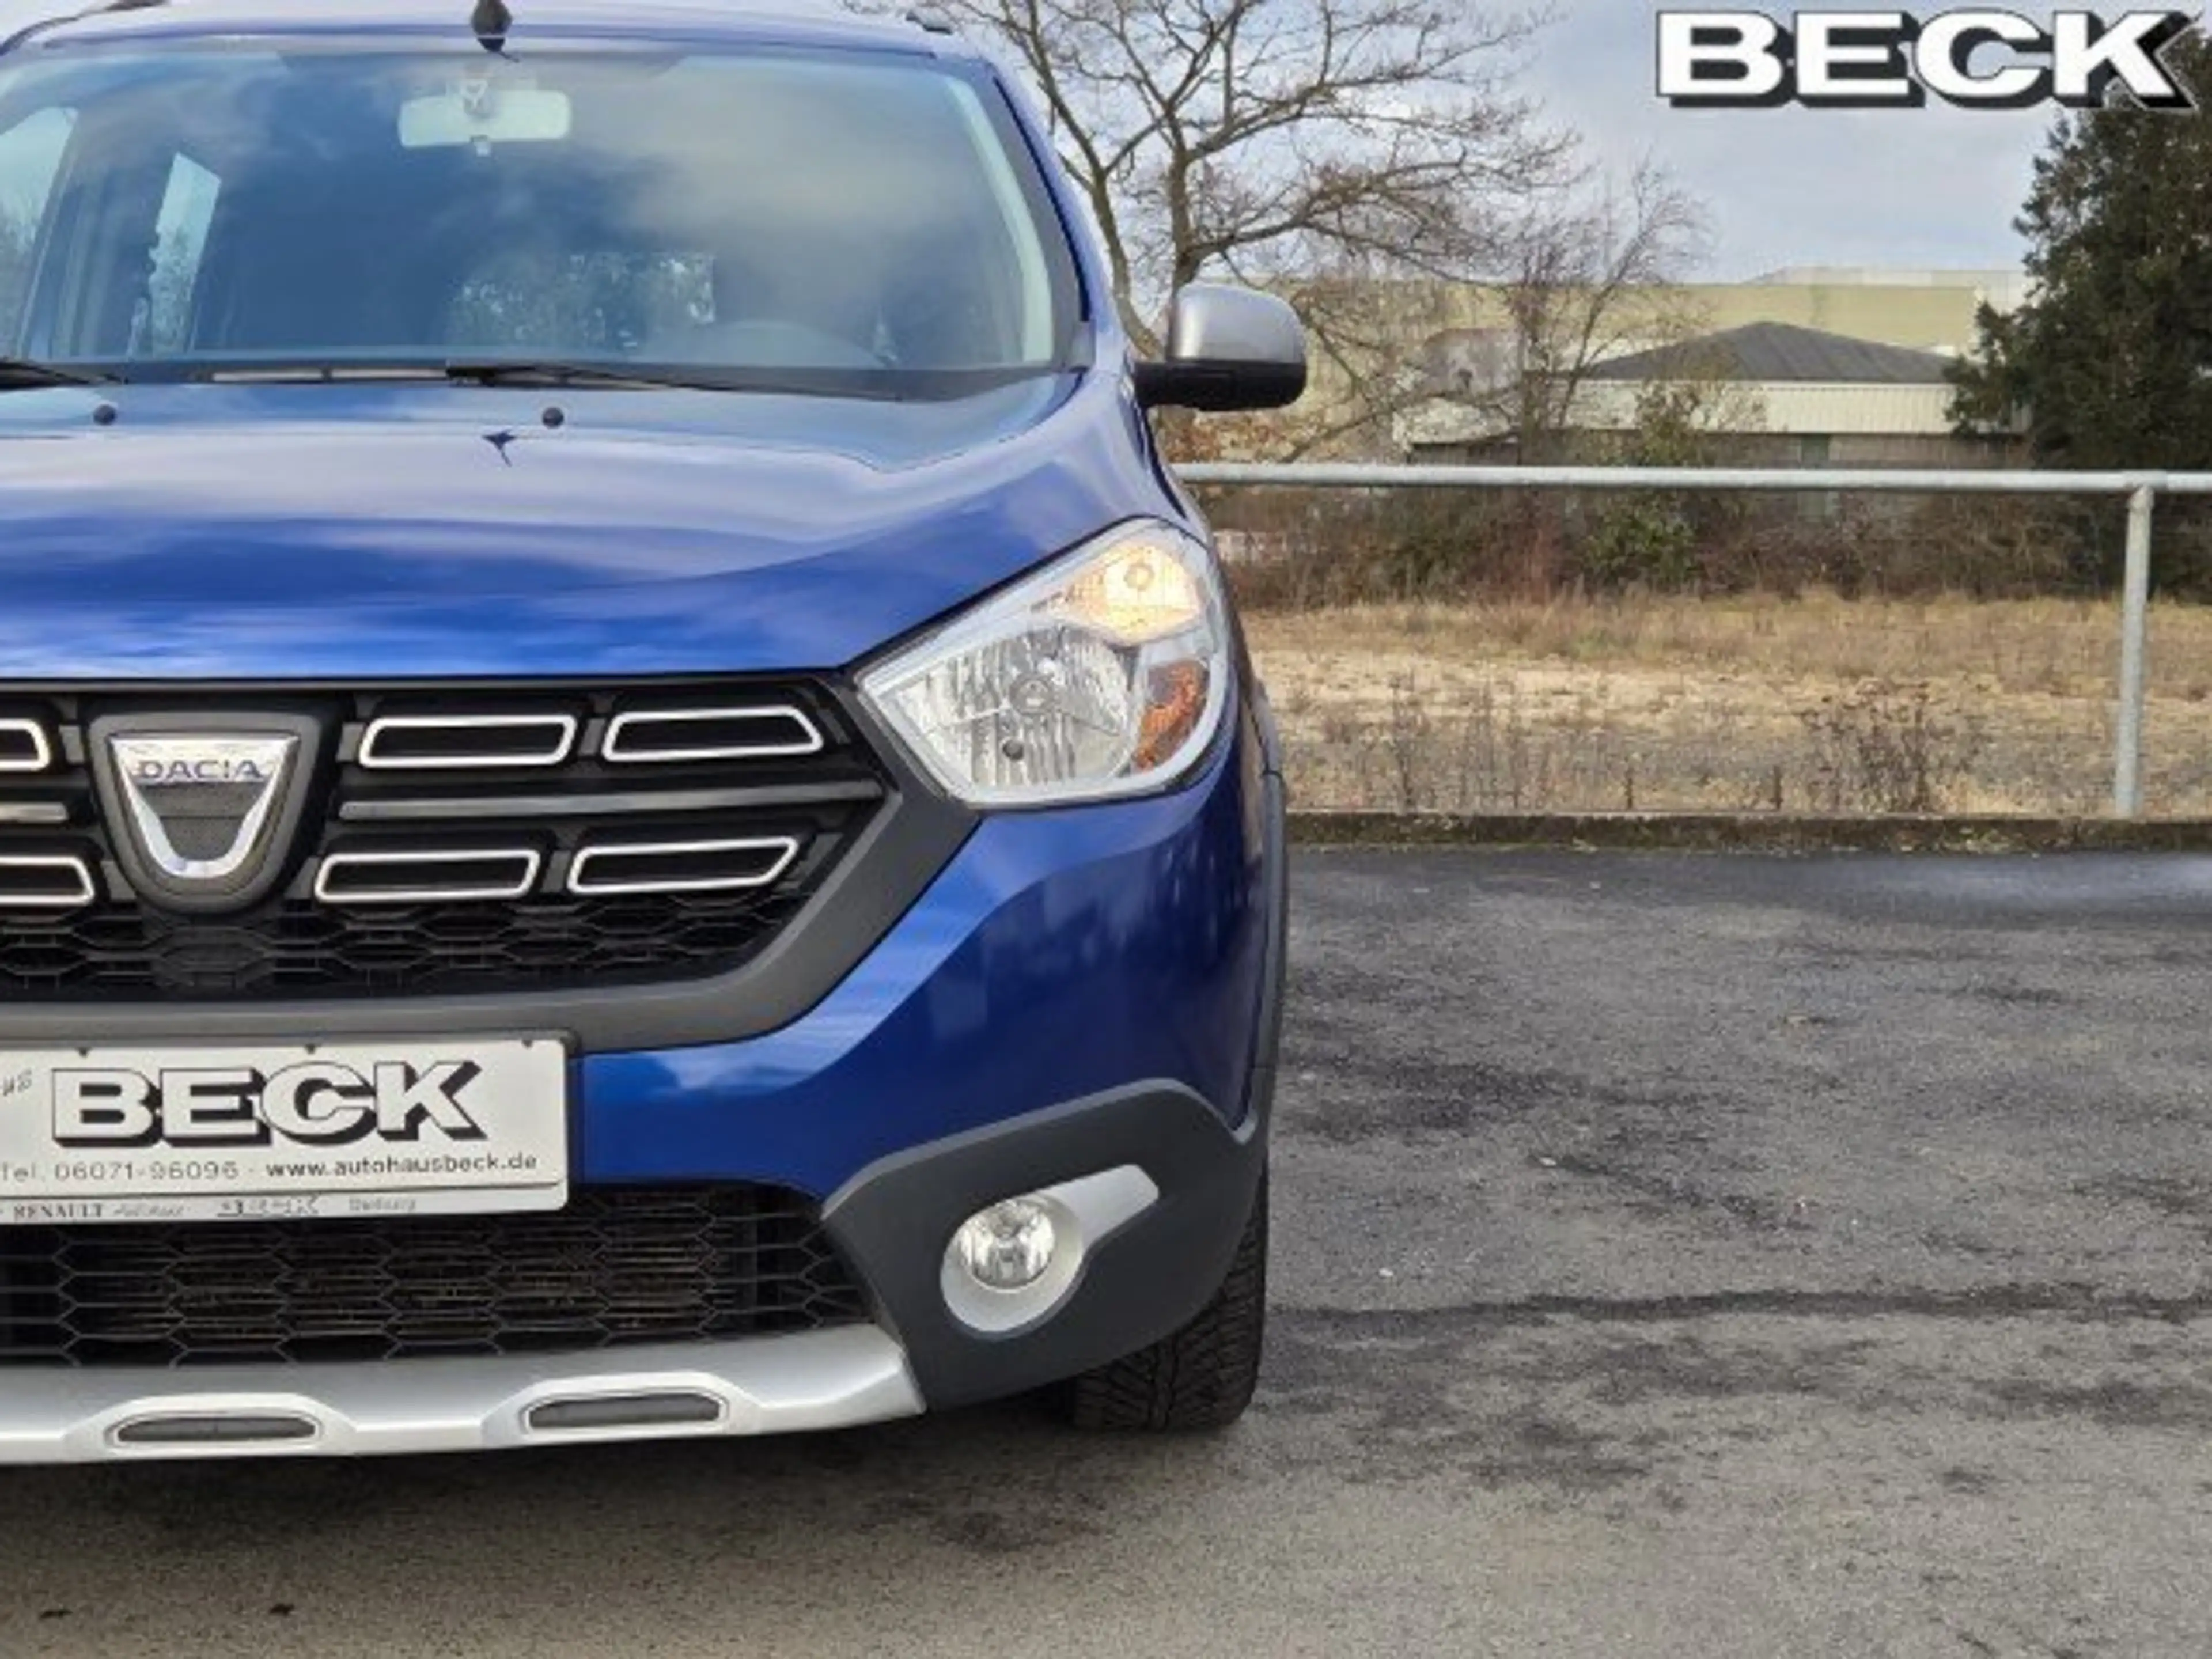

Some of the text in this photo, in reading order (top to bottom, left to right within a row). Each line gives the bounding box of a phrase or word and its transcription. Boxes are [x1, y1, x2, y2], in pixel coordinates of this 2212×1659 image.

[138, 759, 264, 779] DACIA
[51, 1060, 487, 1149] BECK
[265, 1152, 538, 1177] www.autohausbeck.de
